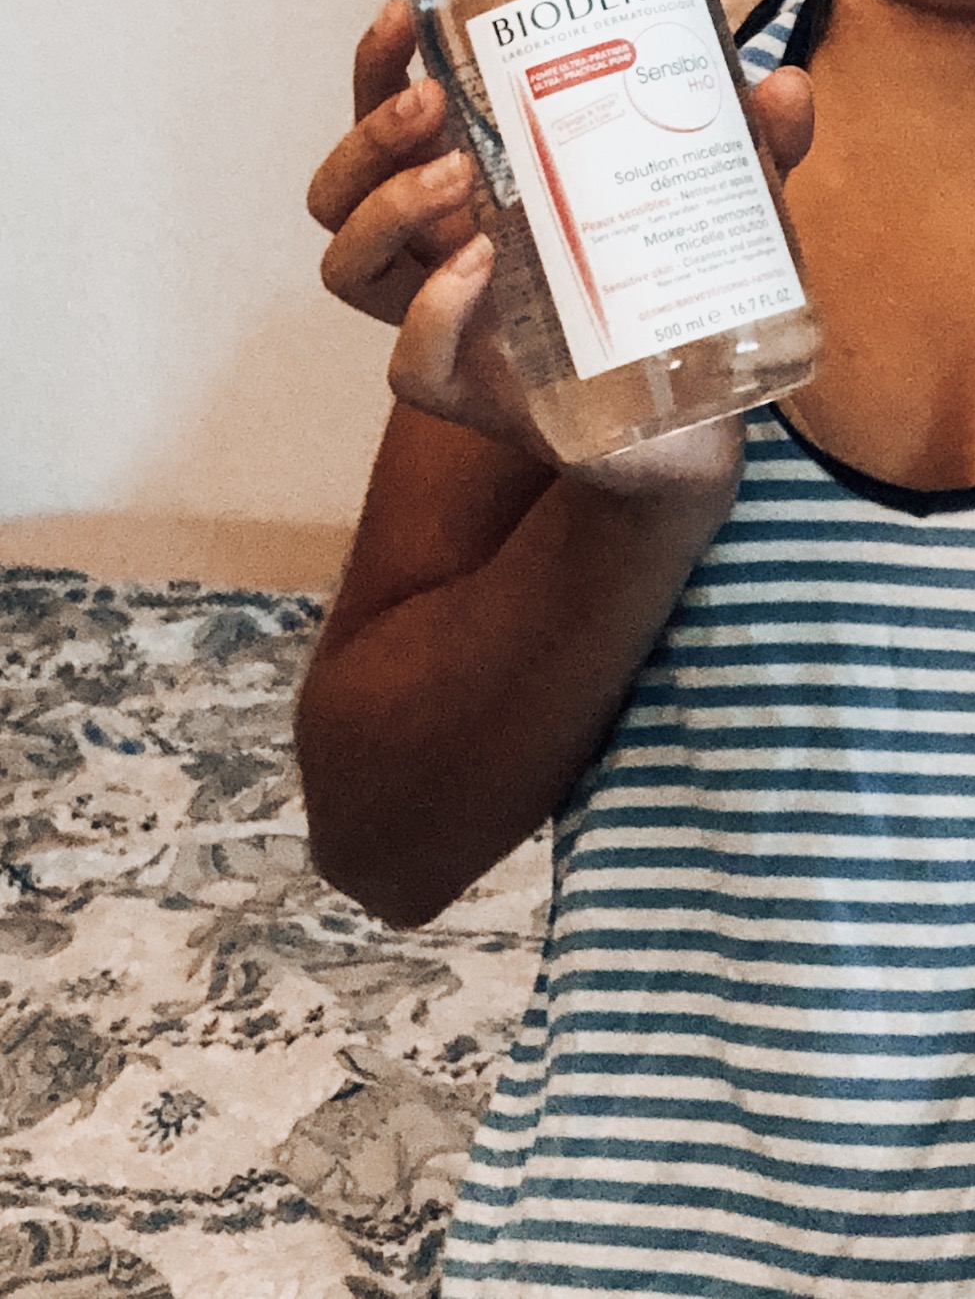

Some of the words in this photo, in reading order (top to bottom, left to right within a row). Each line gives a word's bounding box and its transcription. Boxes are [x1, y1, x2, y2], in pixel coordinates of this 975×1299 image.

[635, 53, 709, 85] Sensibio
[614, 157, 679, 186] Solution
[682, 138, 744, 164] micellaire
[580, 216, 615, 235] Peaux
[617, 197, 671, 222] sensibles
[643, 219, 709, 248] Make-up
[711, 203, 766, 225] removing
[674, 230, 725, 254] micelle
[654, 322, 683, 343] 500
[685, 315, 706, 332] ml
